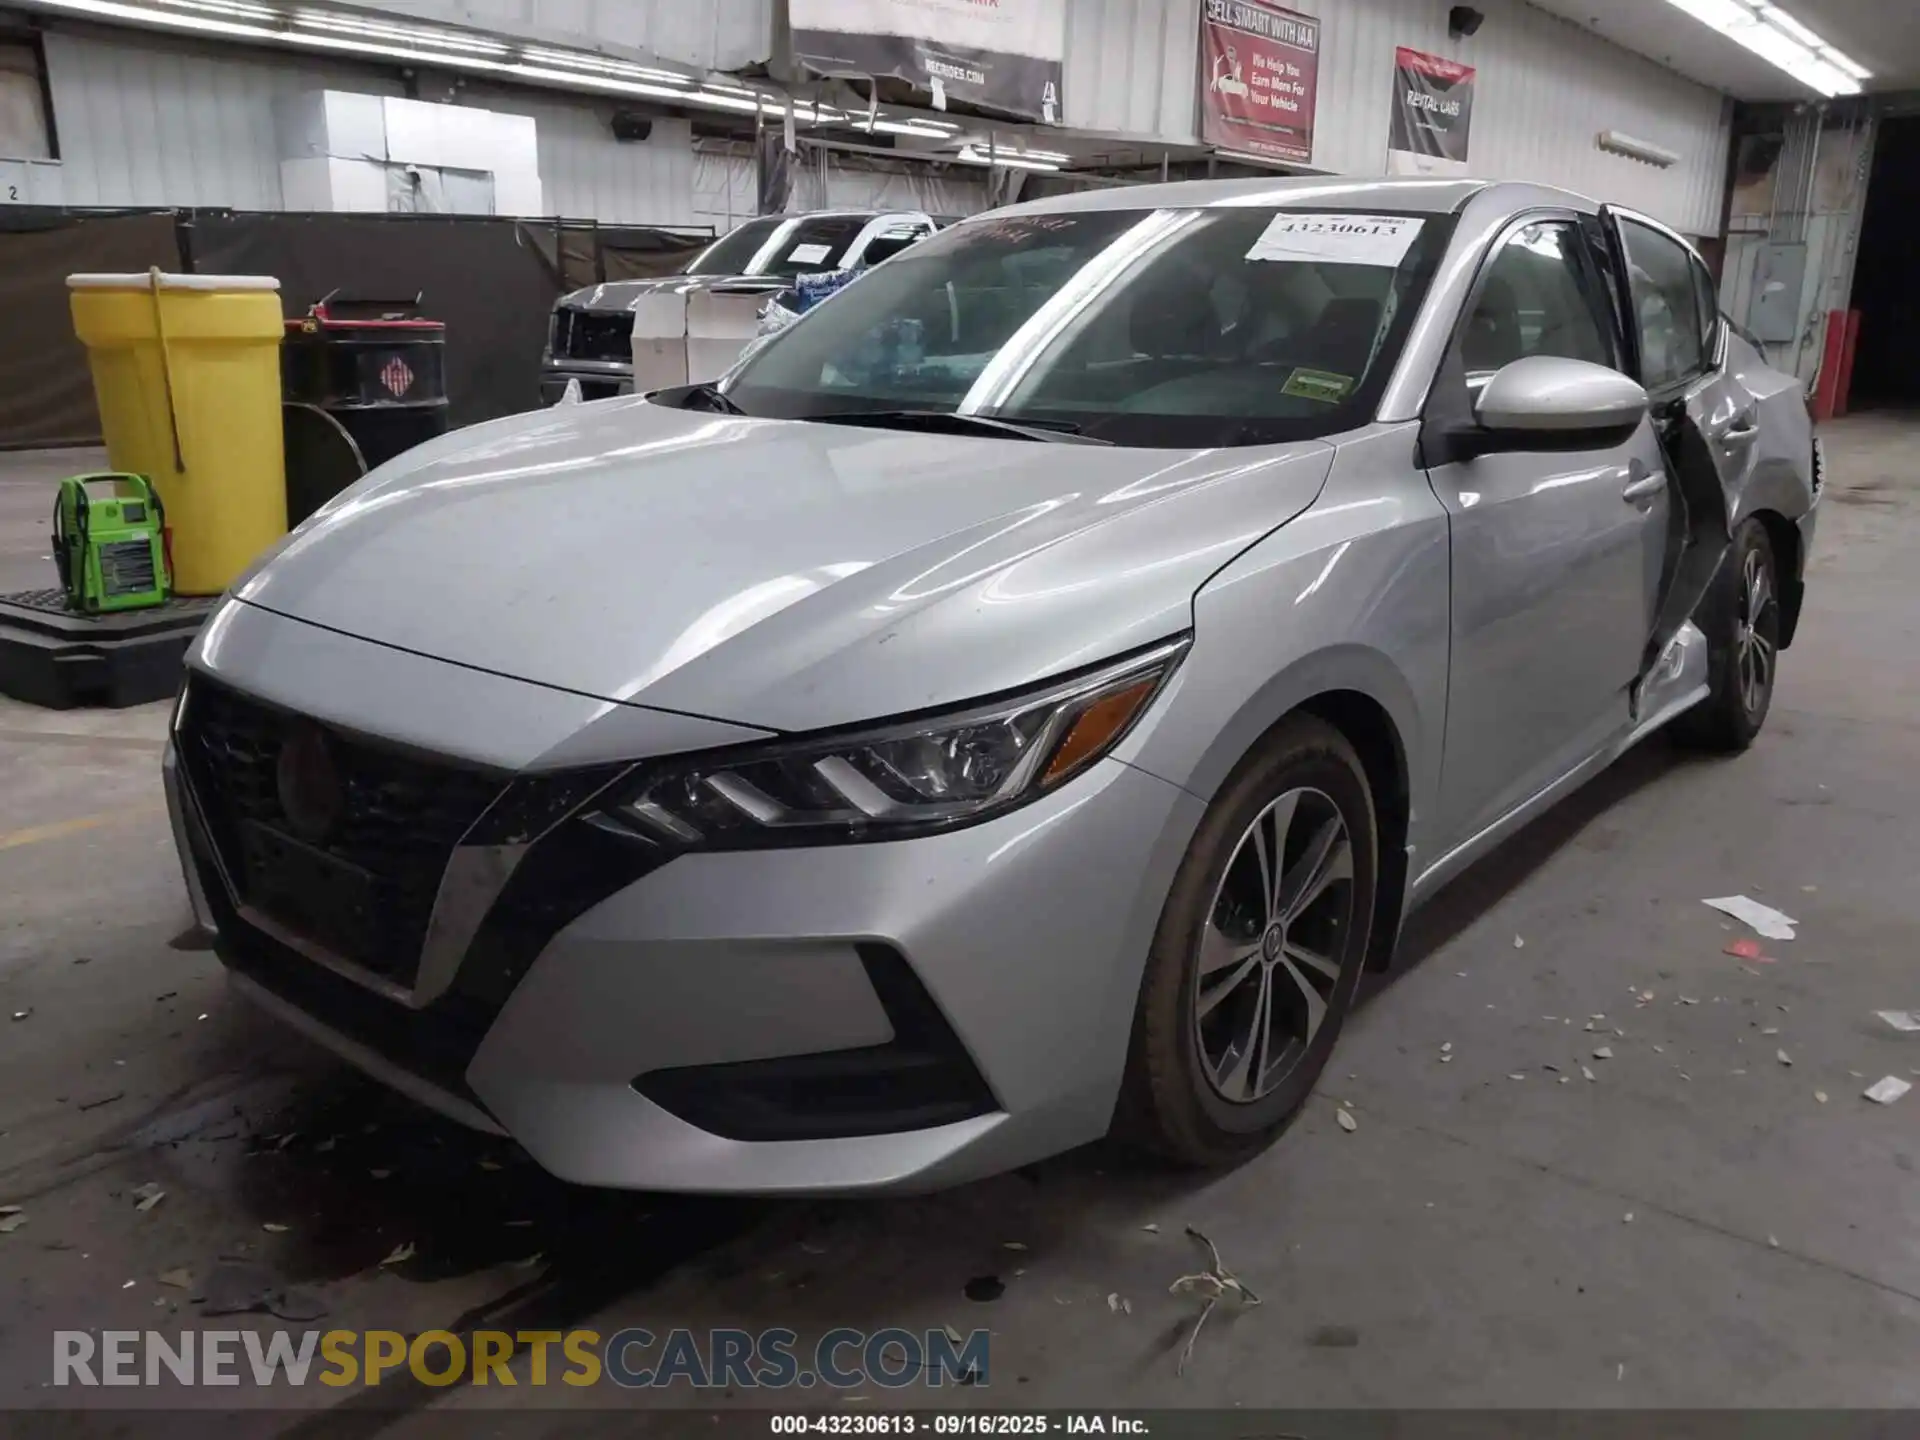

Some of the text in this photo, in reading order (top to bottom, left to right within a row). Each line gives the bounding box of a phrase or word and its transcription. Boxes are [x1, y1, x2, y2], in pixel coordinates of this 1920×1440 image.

[1208, 0, 1313, 48] SELL SMART WITH IAA
[1266, 56, 1285, 76] Help
[1286, 61, 1300, 76] You
[1251, 71, 1305, 96] Earn More For
[1251, 89, 1298, 112] Your Vehicle
[1440, 99, 1461, 117] CARS
[9, 185, 18, 200] 2
